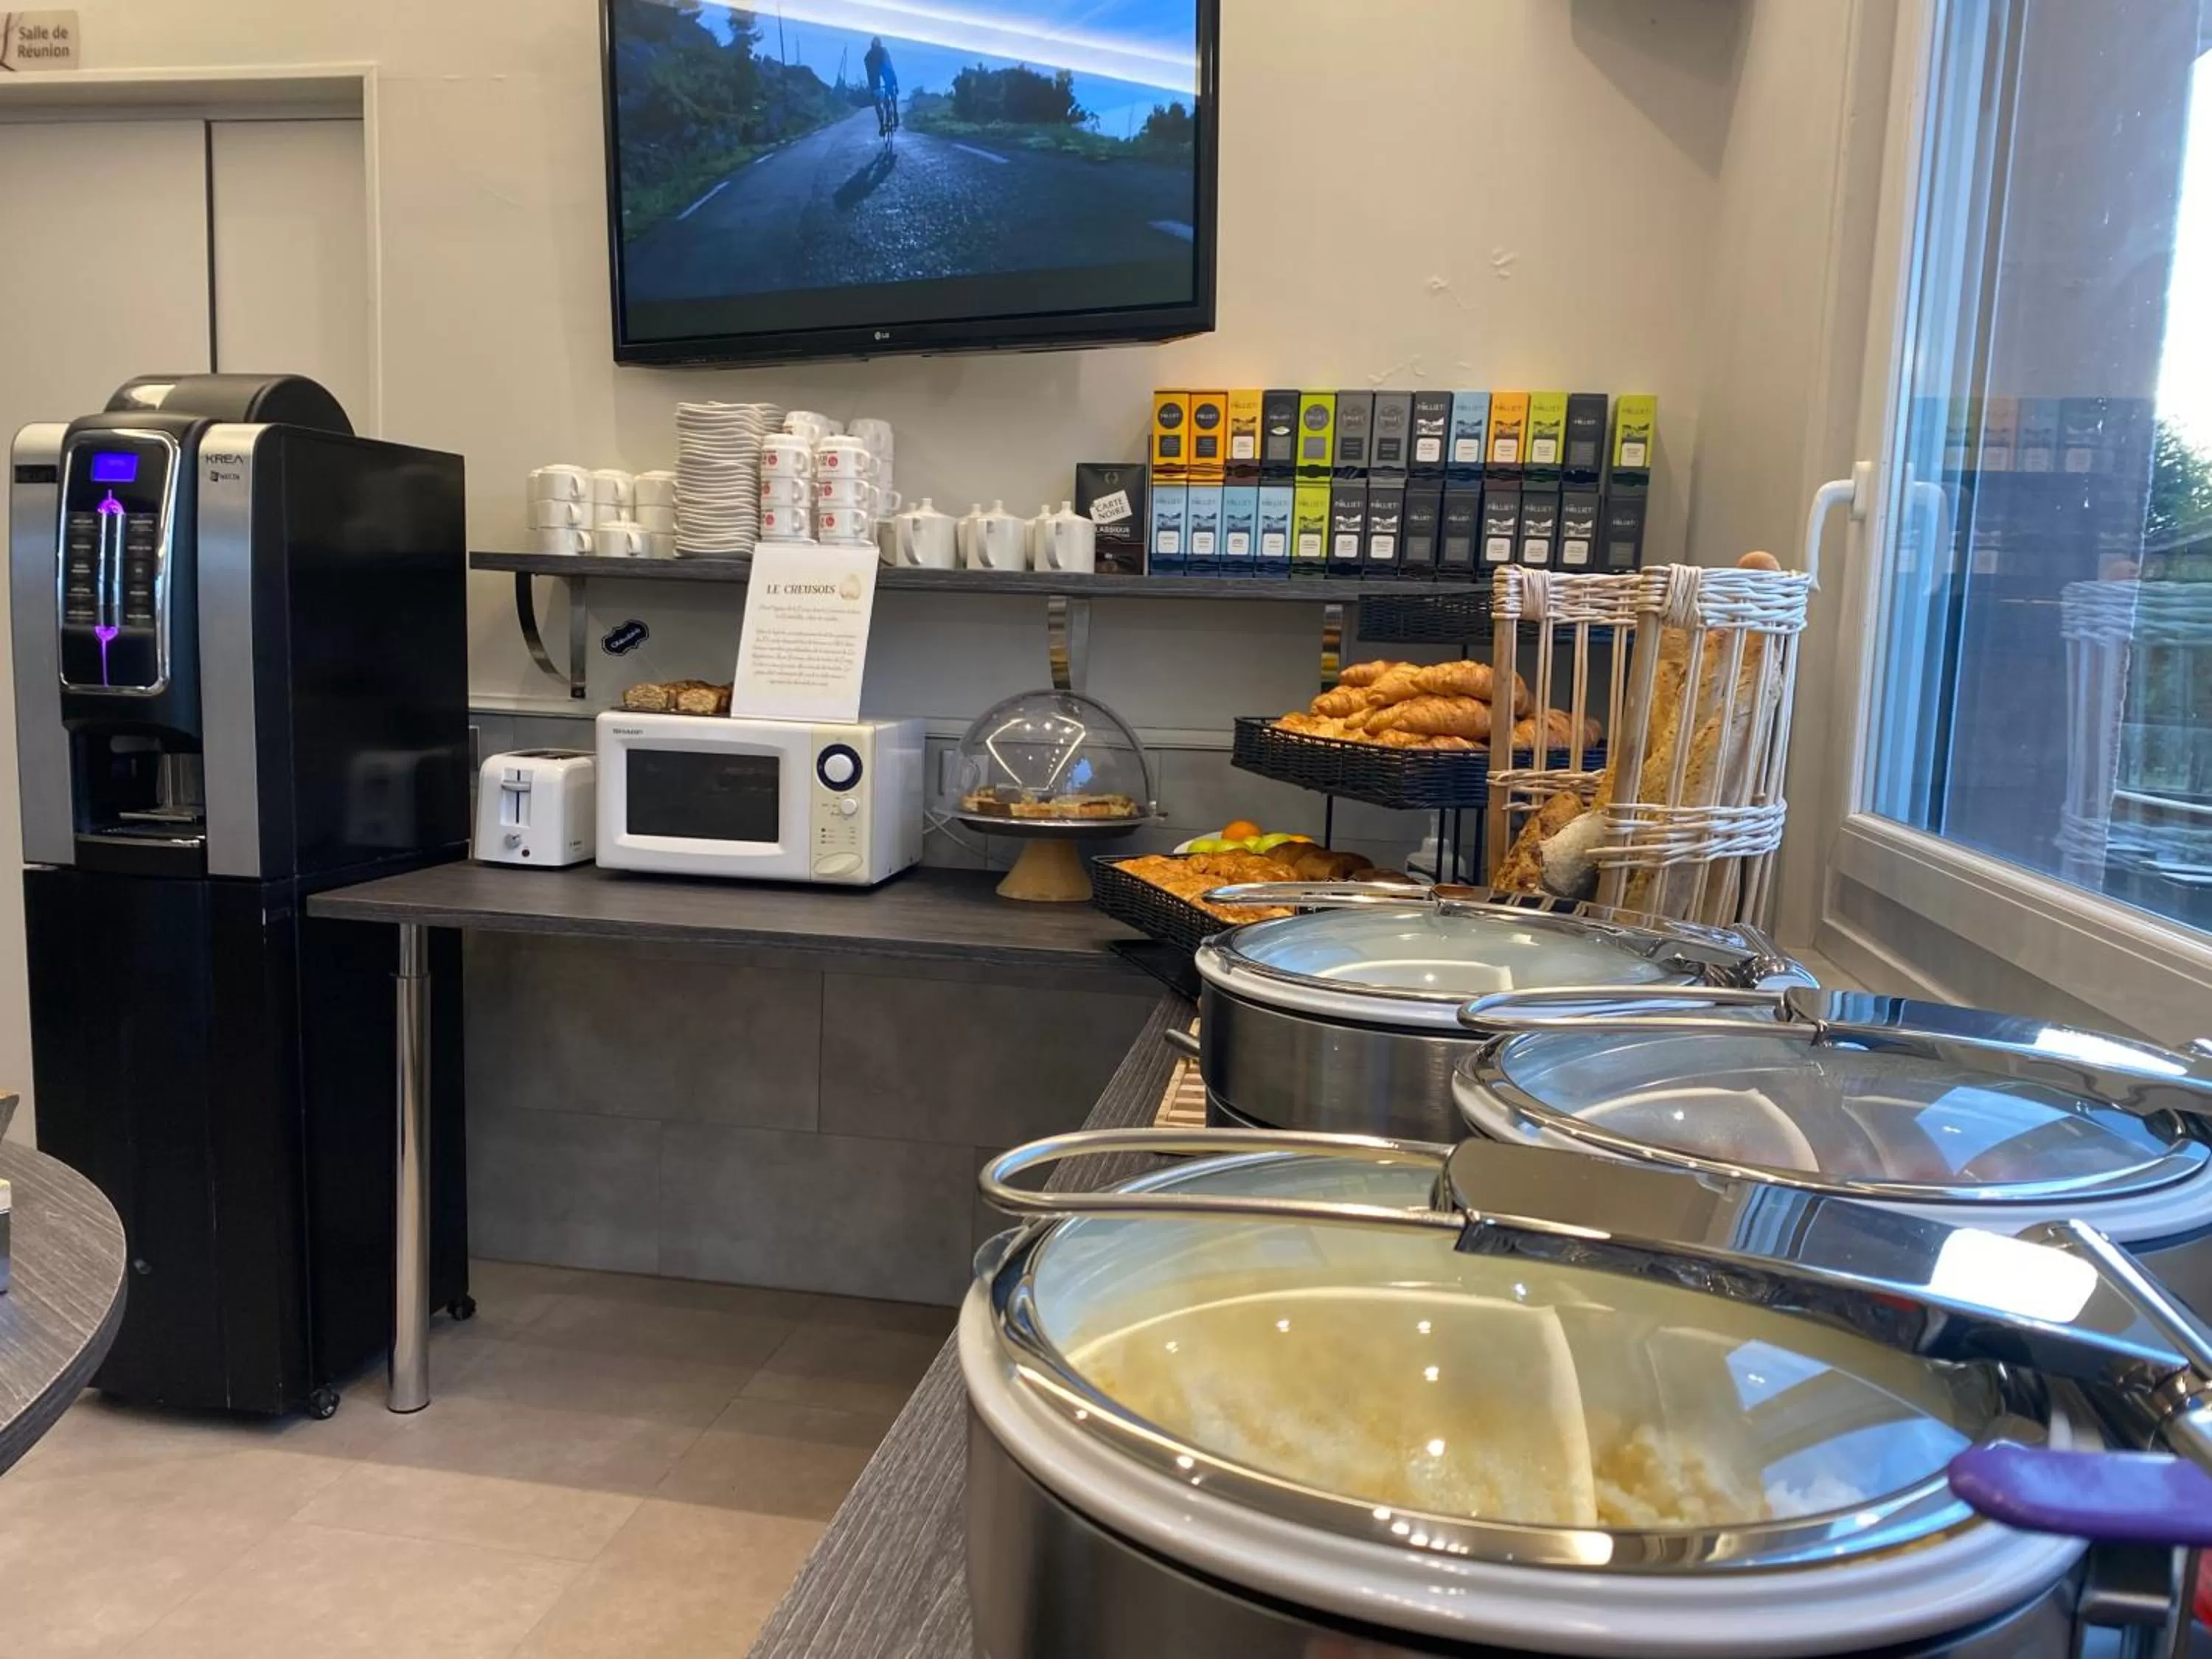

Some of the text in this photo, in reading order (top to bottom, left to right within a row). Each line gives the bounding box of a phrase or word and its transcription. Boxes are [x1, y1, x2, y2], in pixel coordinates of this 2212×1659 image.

[18, 24, 69, 40] Salle de
[18, 42, 70, 58] Réunion
[206, 453, 243, 465] KREA
[1096, 497, 1124, 512] CARTE
[767, 583, 836, 594] LE CREUSOIS
